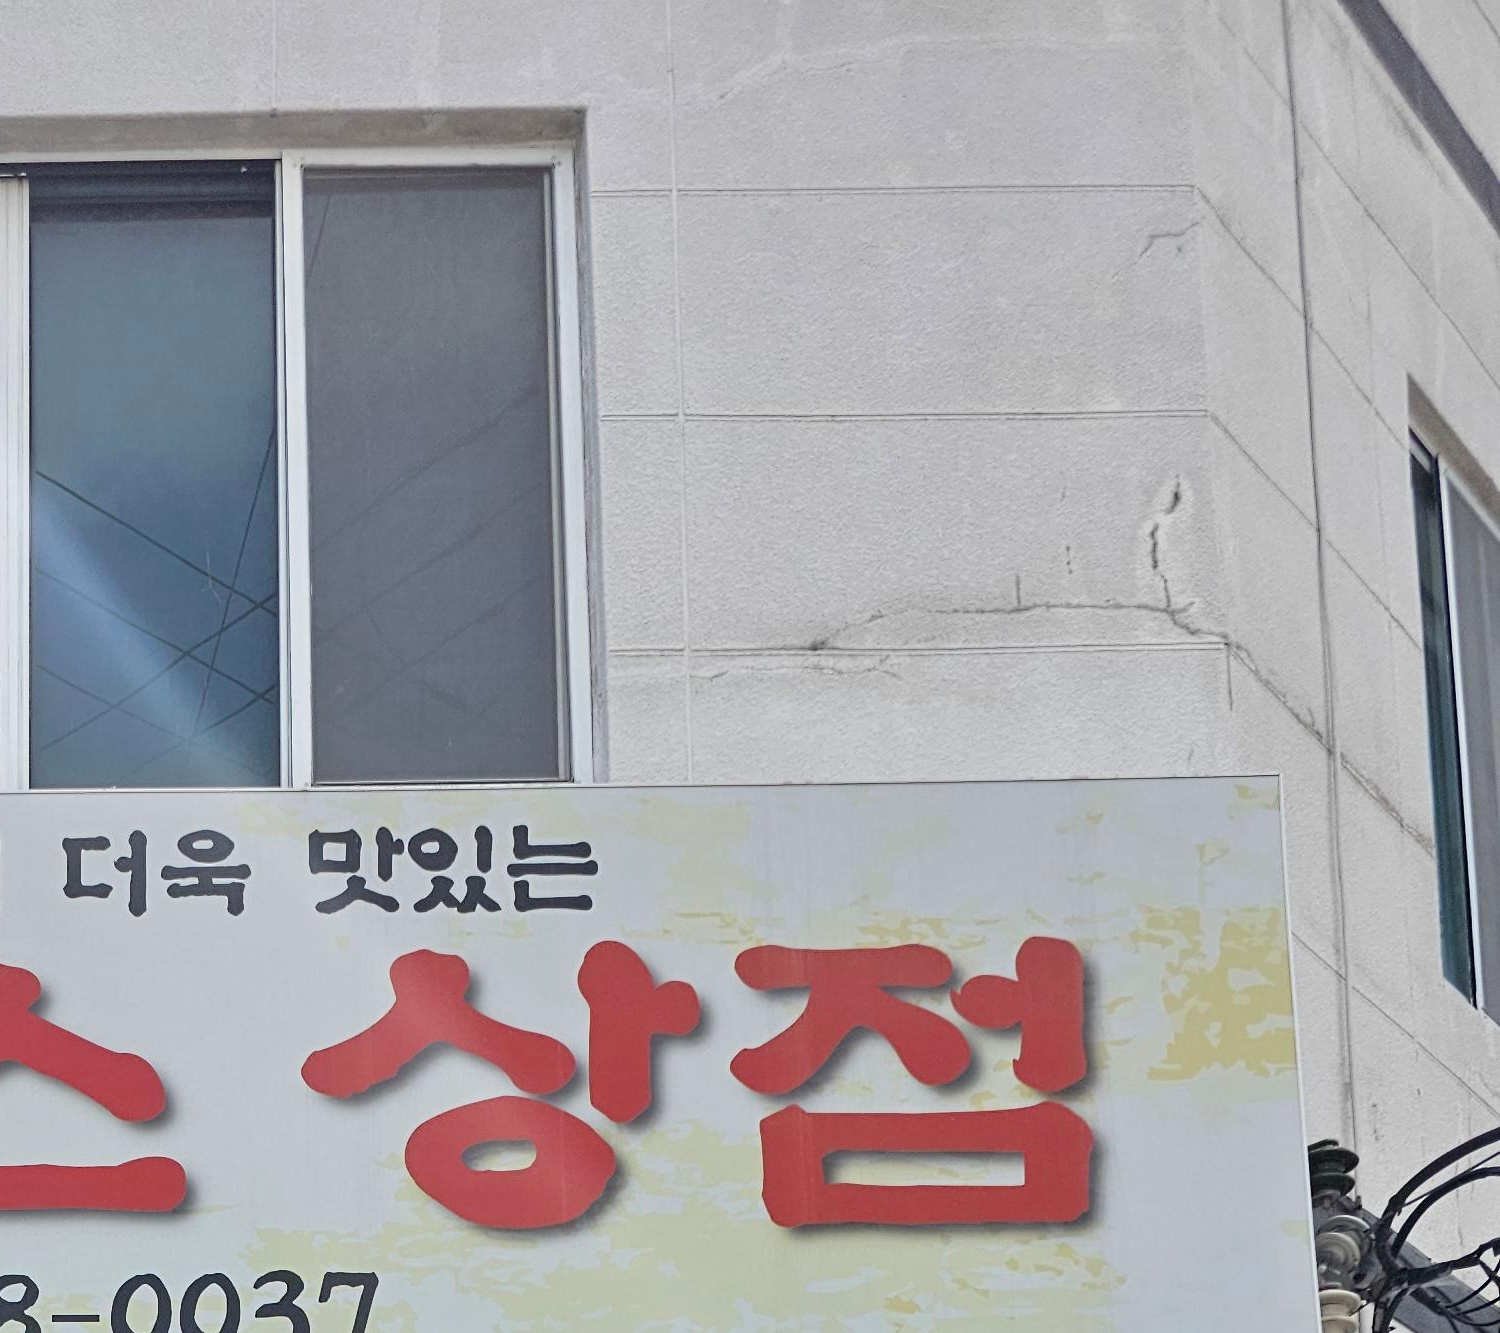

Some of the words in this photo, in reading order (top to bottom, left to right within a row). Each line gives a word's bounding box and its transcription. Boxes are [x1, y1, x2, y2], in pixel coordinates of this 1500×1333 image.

[62, 829, 252, 917] 더욱
[308, 824, 598, 914] 맛있는
[301, 936, 1094, 1232] 상점
